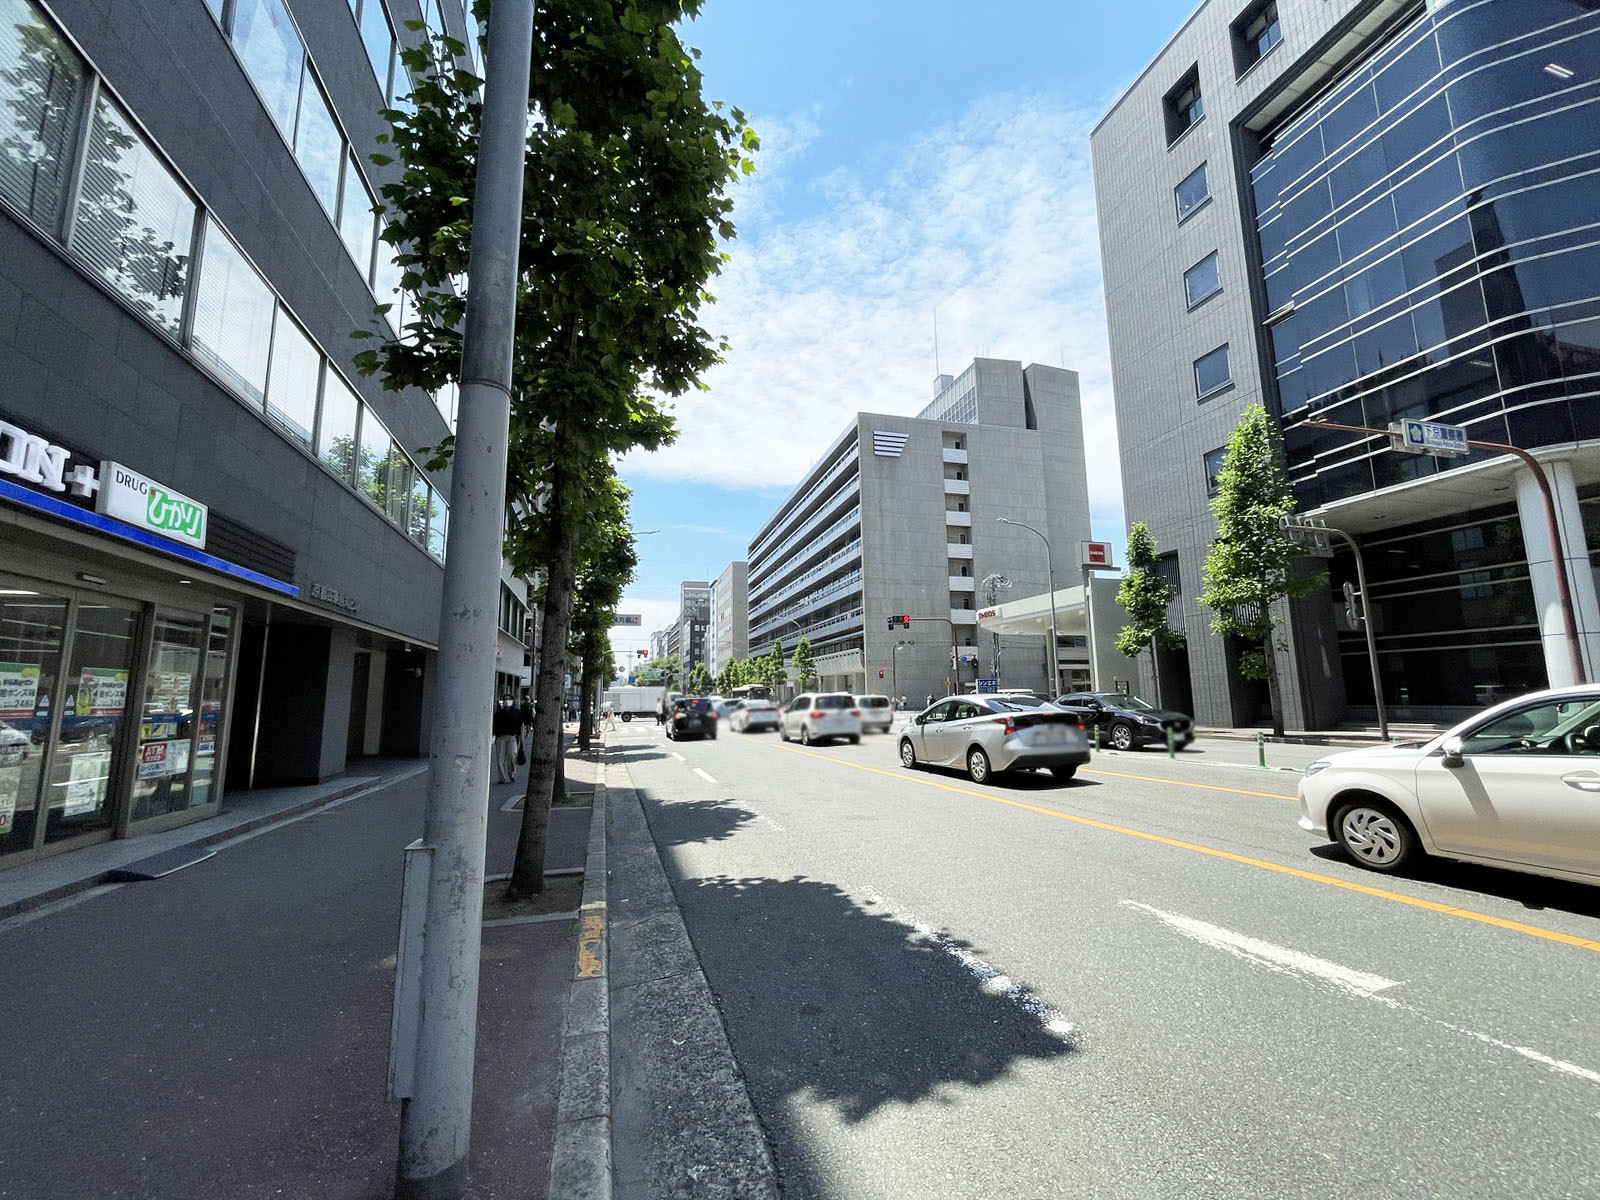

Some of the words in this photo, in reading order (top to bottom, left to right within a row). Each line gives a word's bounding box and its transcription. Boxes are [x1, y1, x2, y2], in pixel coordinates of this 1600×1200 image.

[116, 471, 148, 495] DRUG
[150, 489, 201, 535] ひかり
[145, 745, 164, 757] ATM
